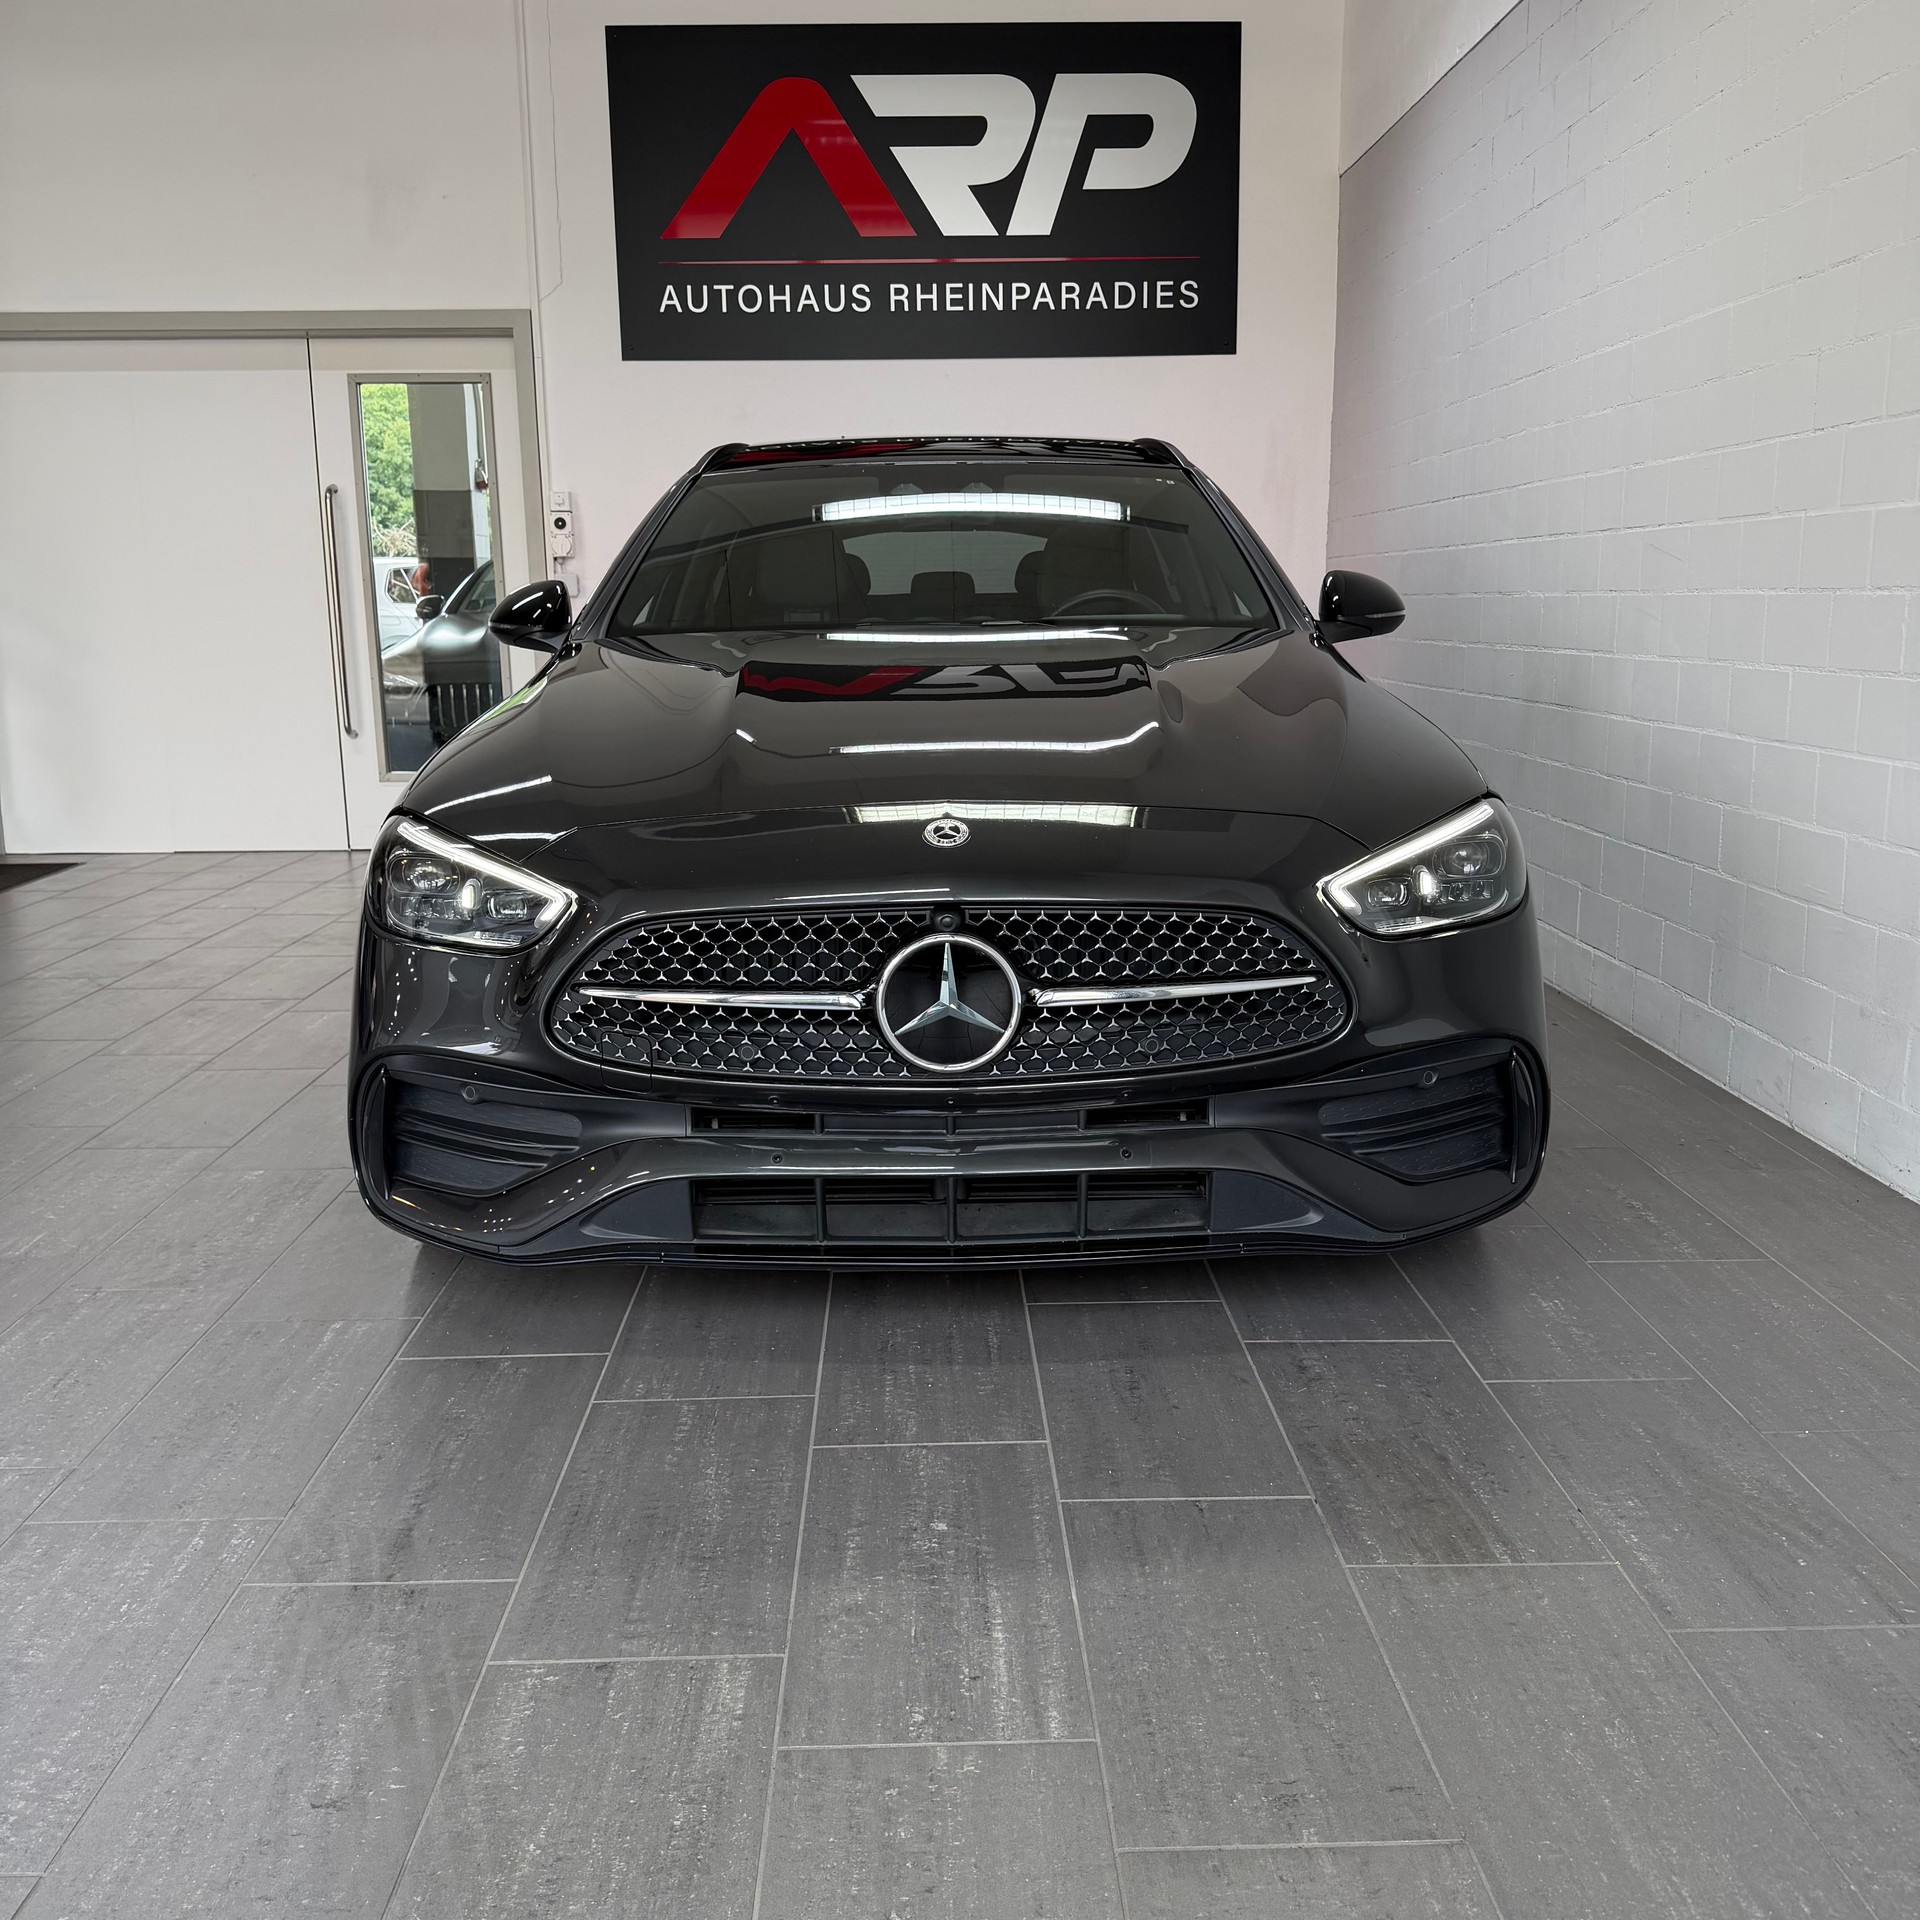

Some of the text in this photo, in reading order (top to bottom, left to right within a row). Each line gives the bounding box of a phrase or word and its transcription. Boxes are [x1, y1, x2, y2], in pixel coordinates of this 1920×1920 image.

[660, 73, 1197, 239] ARP
[659, 280, 1199, 314] AUTOHAUS RHEINPARADIES
